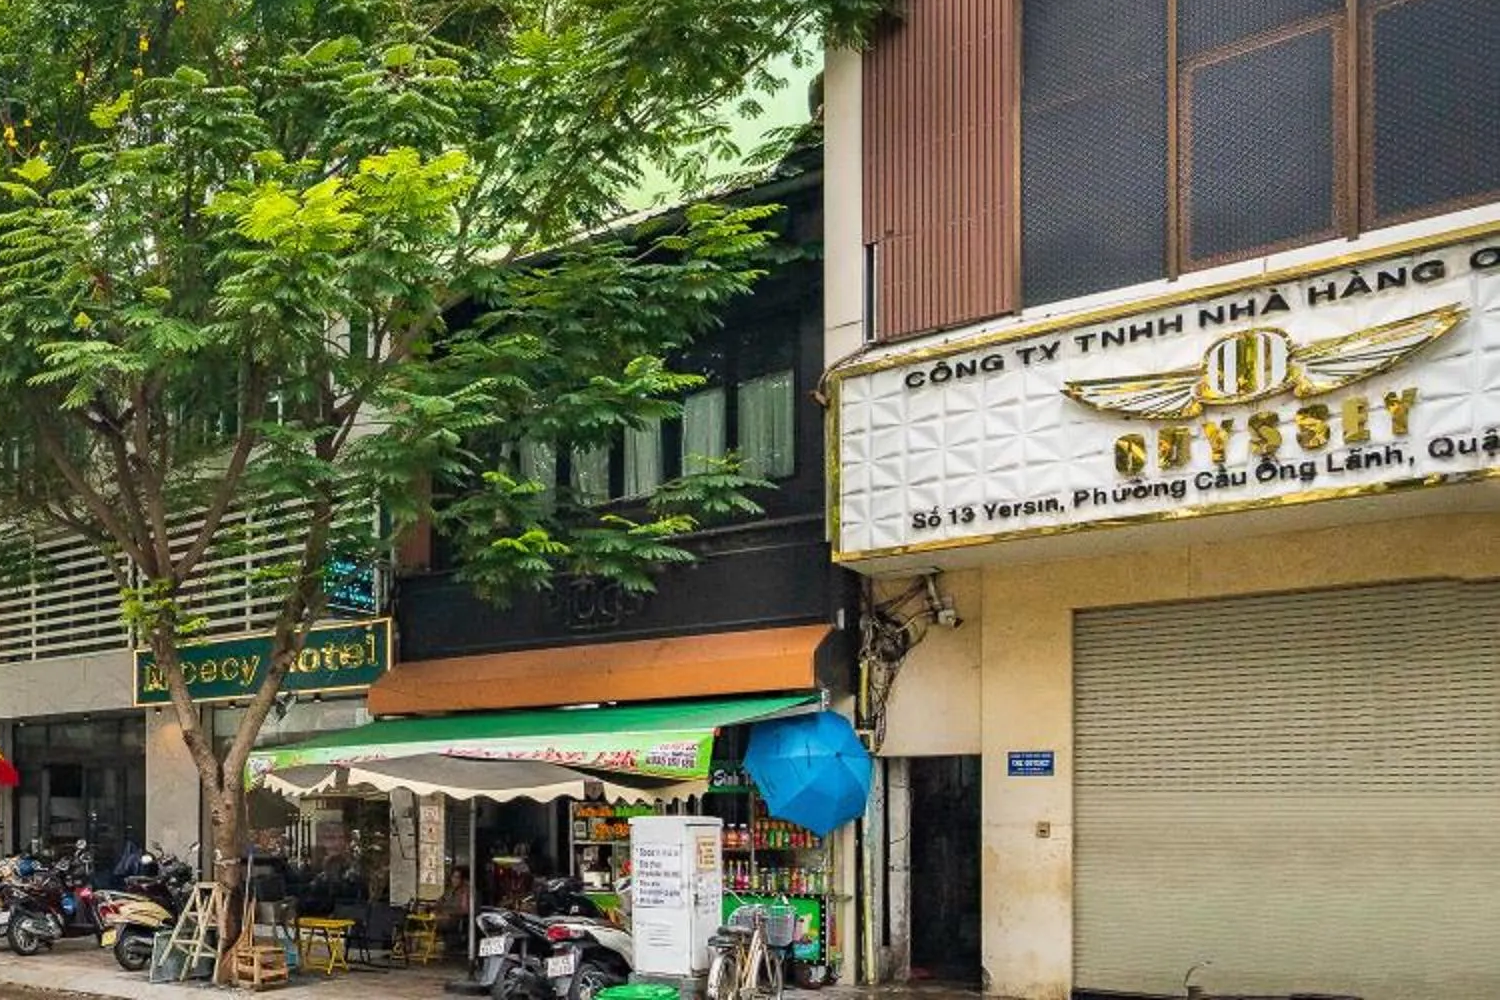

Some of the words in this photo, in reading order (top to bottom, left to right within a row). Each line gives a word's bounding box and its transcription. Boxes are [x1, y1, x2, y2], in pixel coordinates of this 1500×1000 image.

[905, 360, 1004, 389] CÔNG
[1016, 341, 1060, 365] TY
[1074, 313, 1183, 353] TNHH
[1199, 288, 1290, 328] NHÀ
[1308, 260, 1446, 305] HÀNG
[1114, 387, 1418, 476] ODYSSEY
[912, 505, 942, 530] Số
[949, 508, 976, 526] 13
[1073, 478, 1187, 508] Phường
[289, 632, 379, 673] otel
